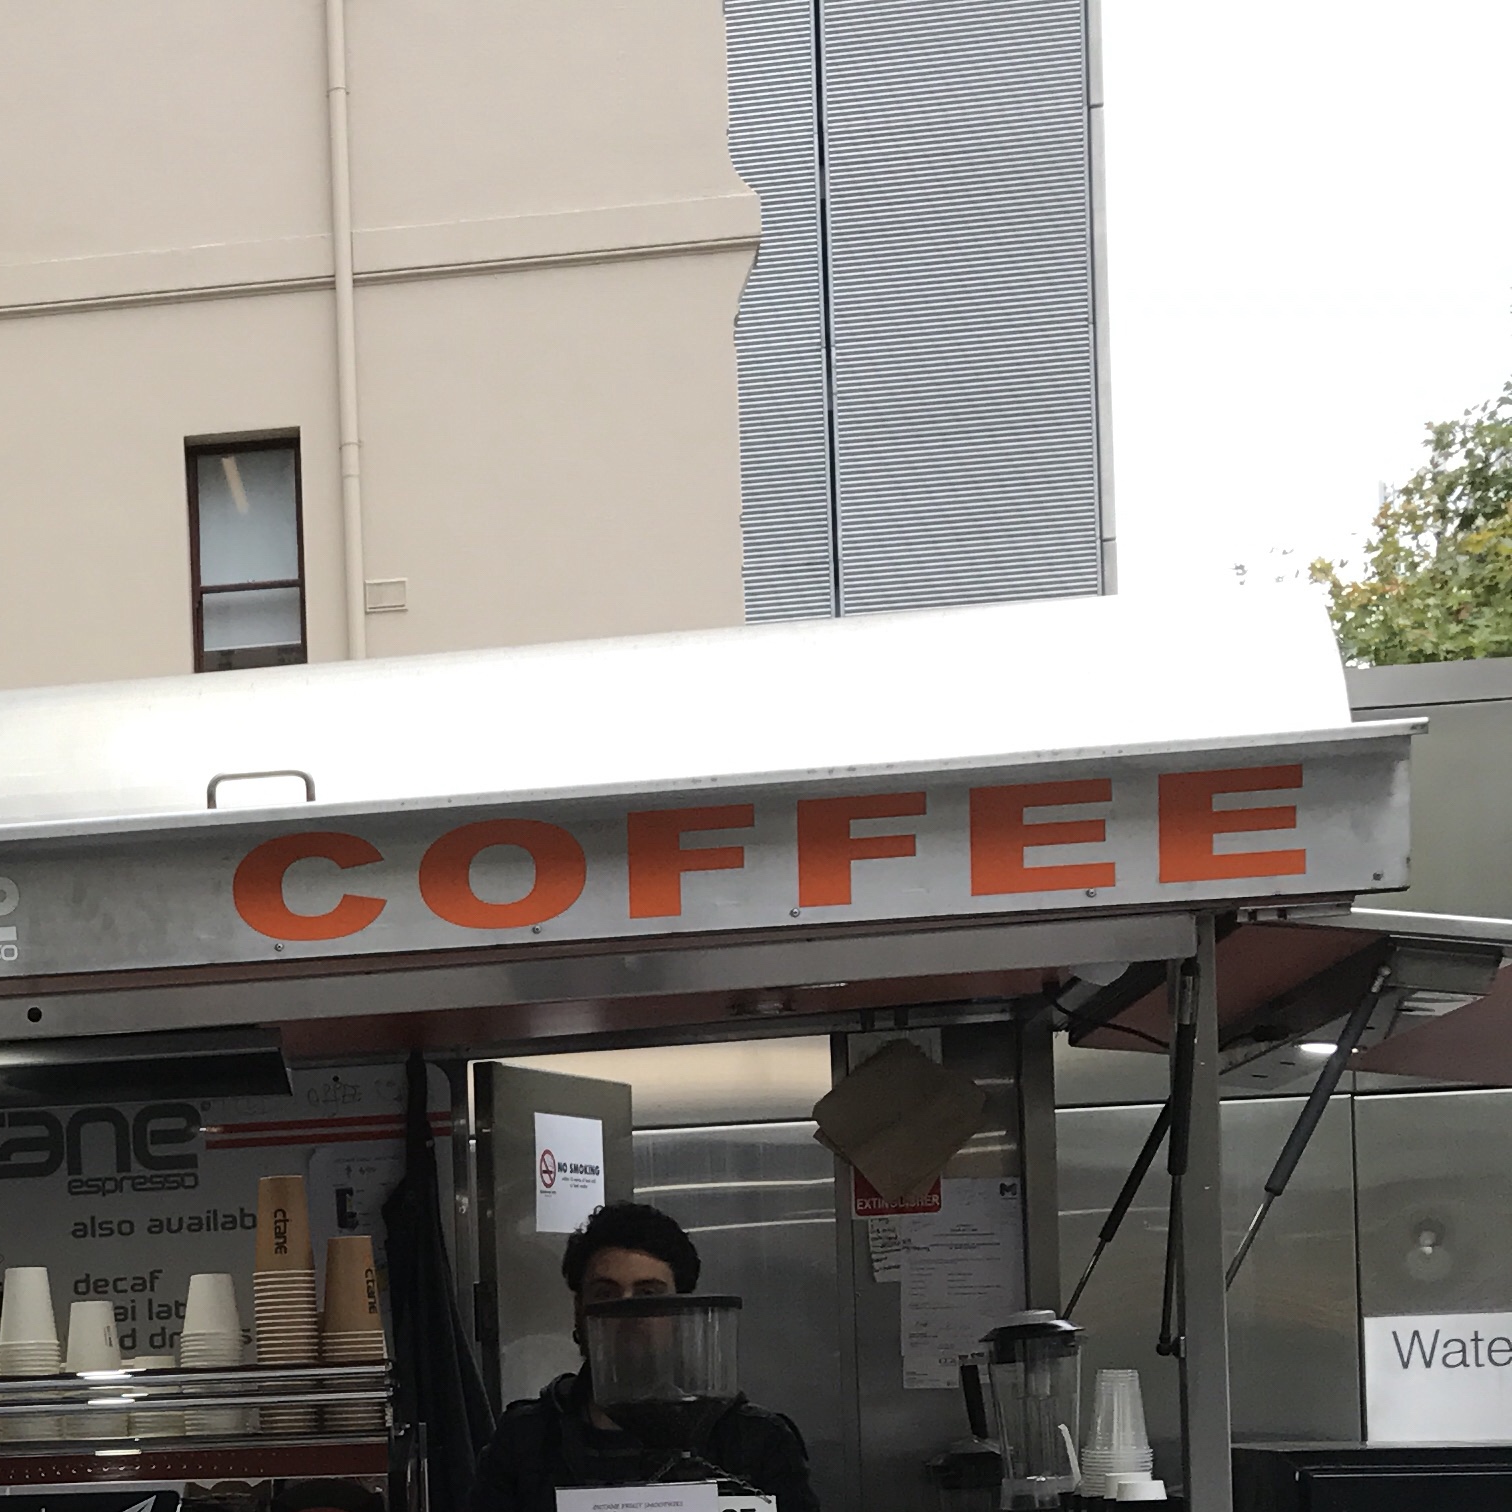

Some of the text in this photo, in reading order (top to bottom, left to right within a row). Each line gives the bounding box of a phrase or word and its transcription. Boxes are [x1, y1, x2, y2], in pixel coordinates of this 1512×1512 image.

[232, 763, 1307, 943] COFFEE
[558, 1162, 600, 1176] NO SMOKING
[67, 1173, 200, 1198] espresso
[71, 1207, 257, 1239] also availab
[73, 1269, 163, 1296] decaf
[148, 1298, 187, 1321] lat
